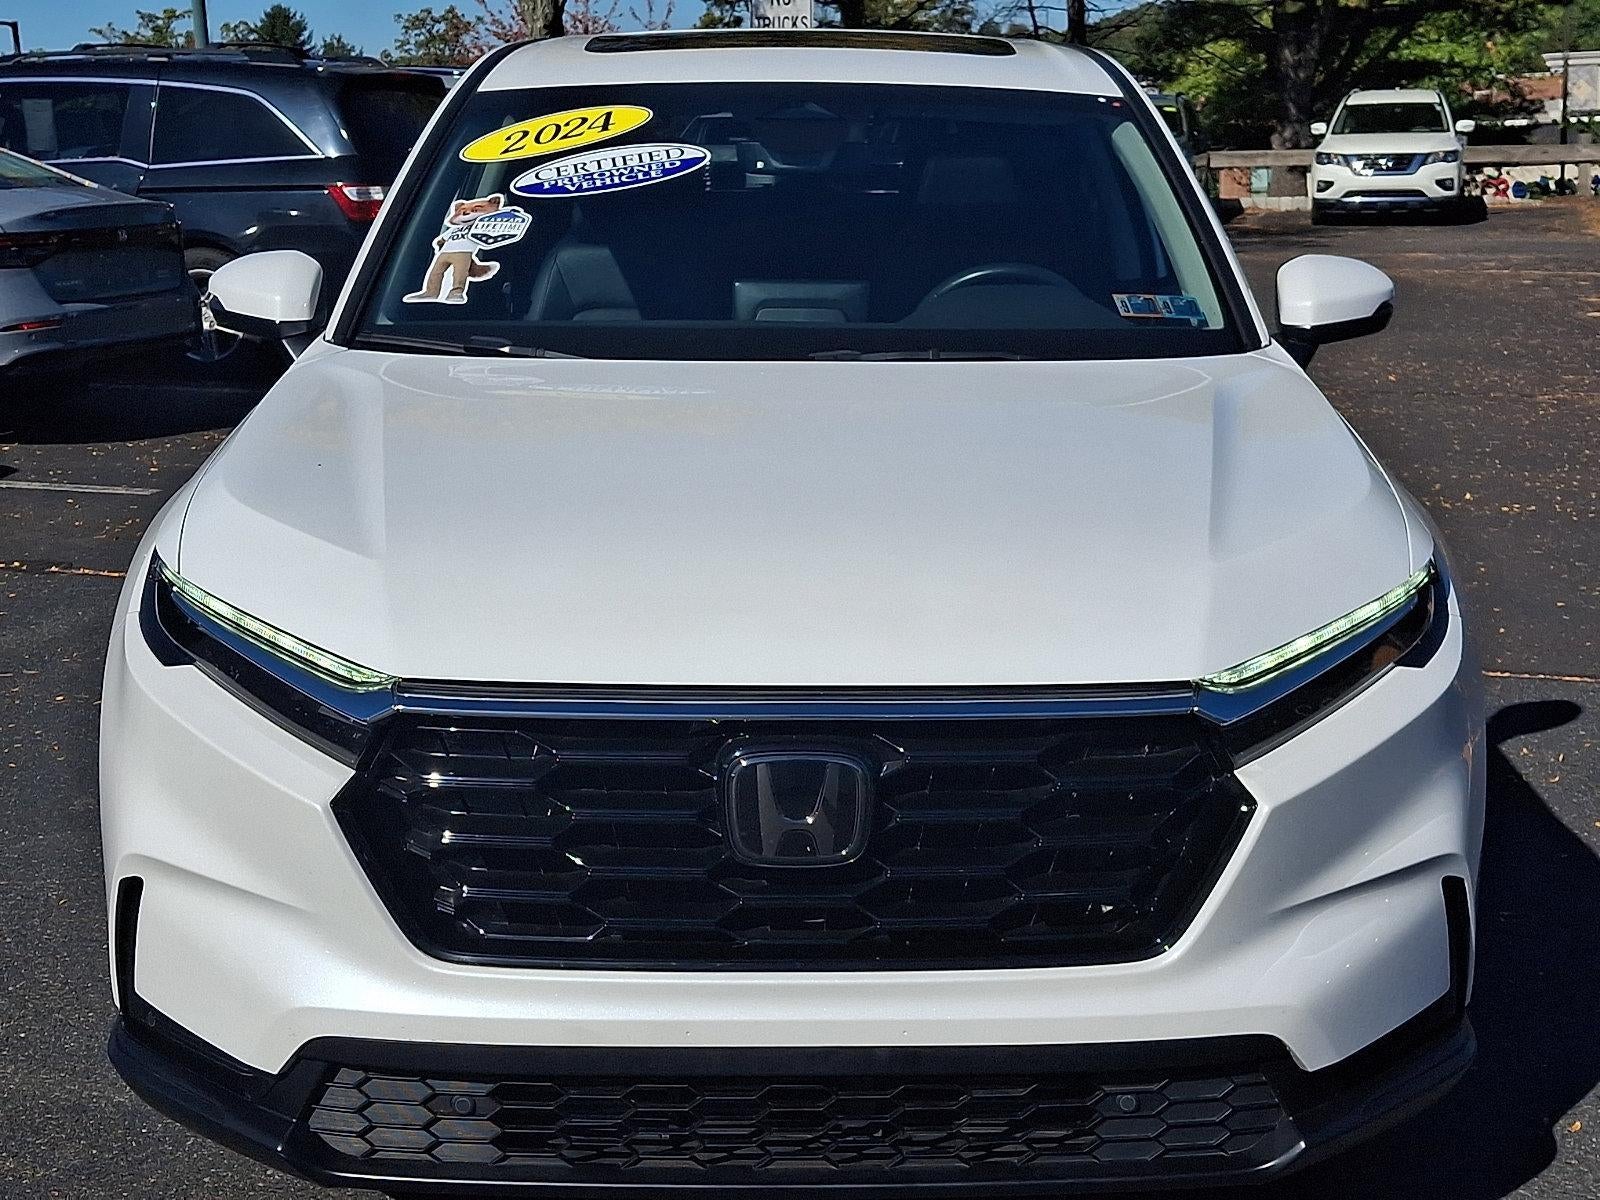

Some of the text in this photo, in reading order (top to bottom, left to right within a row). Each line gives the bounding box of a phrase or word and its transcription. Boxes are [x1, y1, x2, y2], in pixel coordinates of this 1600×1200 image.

[755, 15, 809, 28] TRUCKS
[500, 111, 616, 155] 2024
[535, 147, 685, 181] CERTIFIED
[543, 160, 681, 189] PRE-OWNED
[564, 169, 663, 191] VEHICLE
